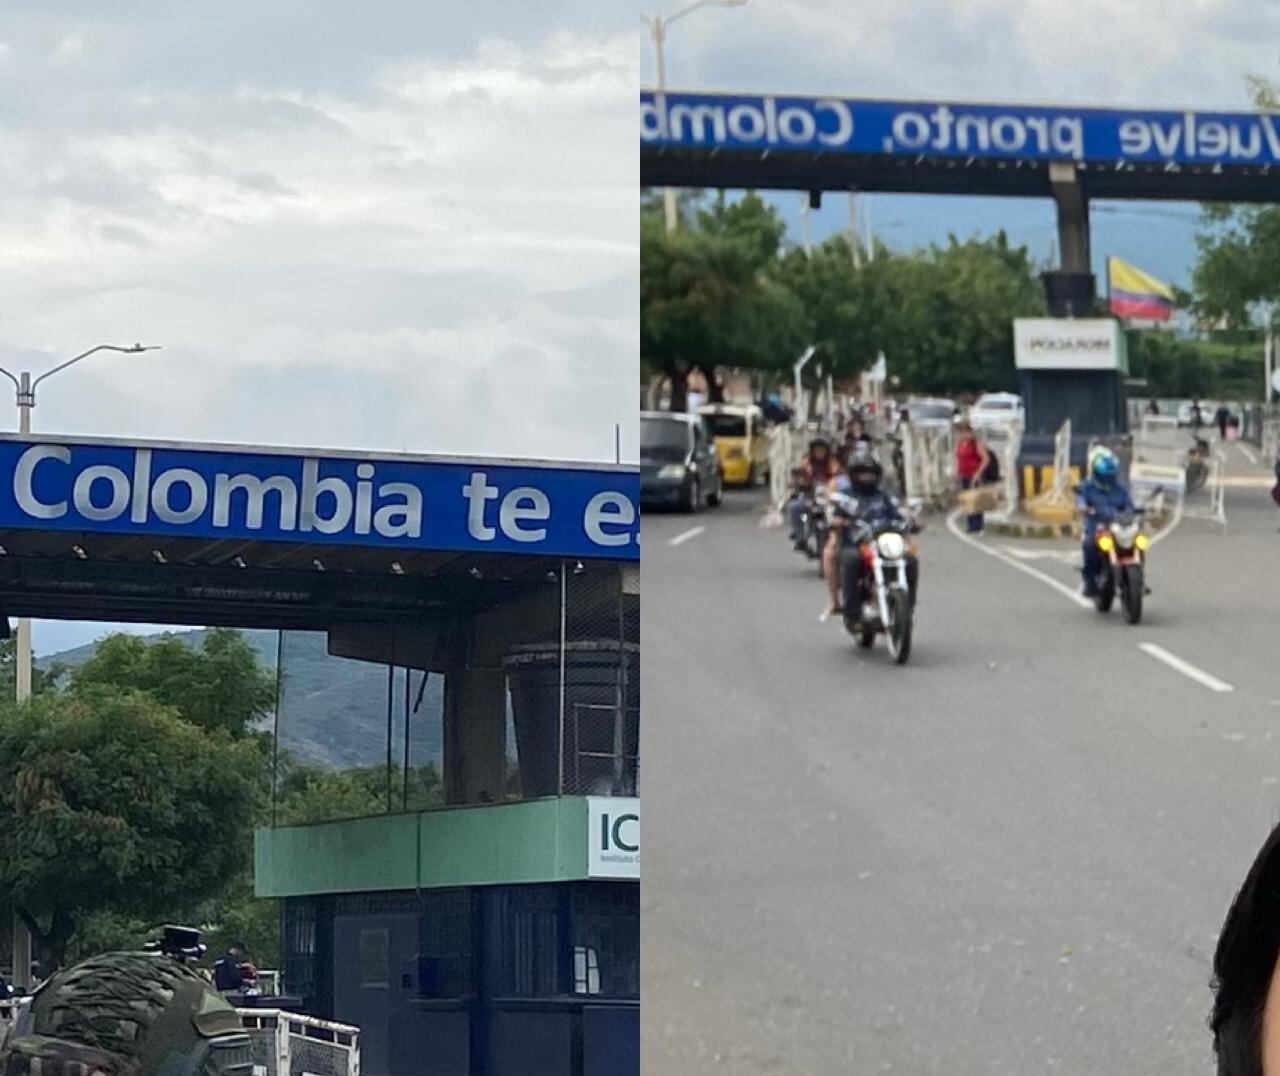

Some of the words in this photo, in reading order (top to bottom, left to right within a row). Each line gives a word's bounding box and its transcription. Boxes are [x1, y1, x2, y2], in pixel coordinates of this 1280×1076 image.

[13, 445, 424, 539] Colombia
[463, 472, 551, 542] te
[584, 490, 640, 546] e
[602, 813, 640, 852] IC
